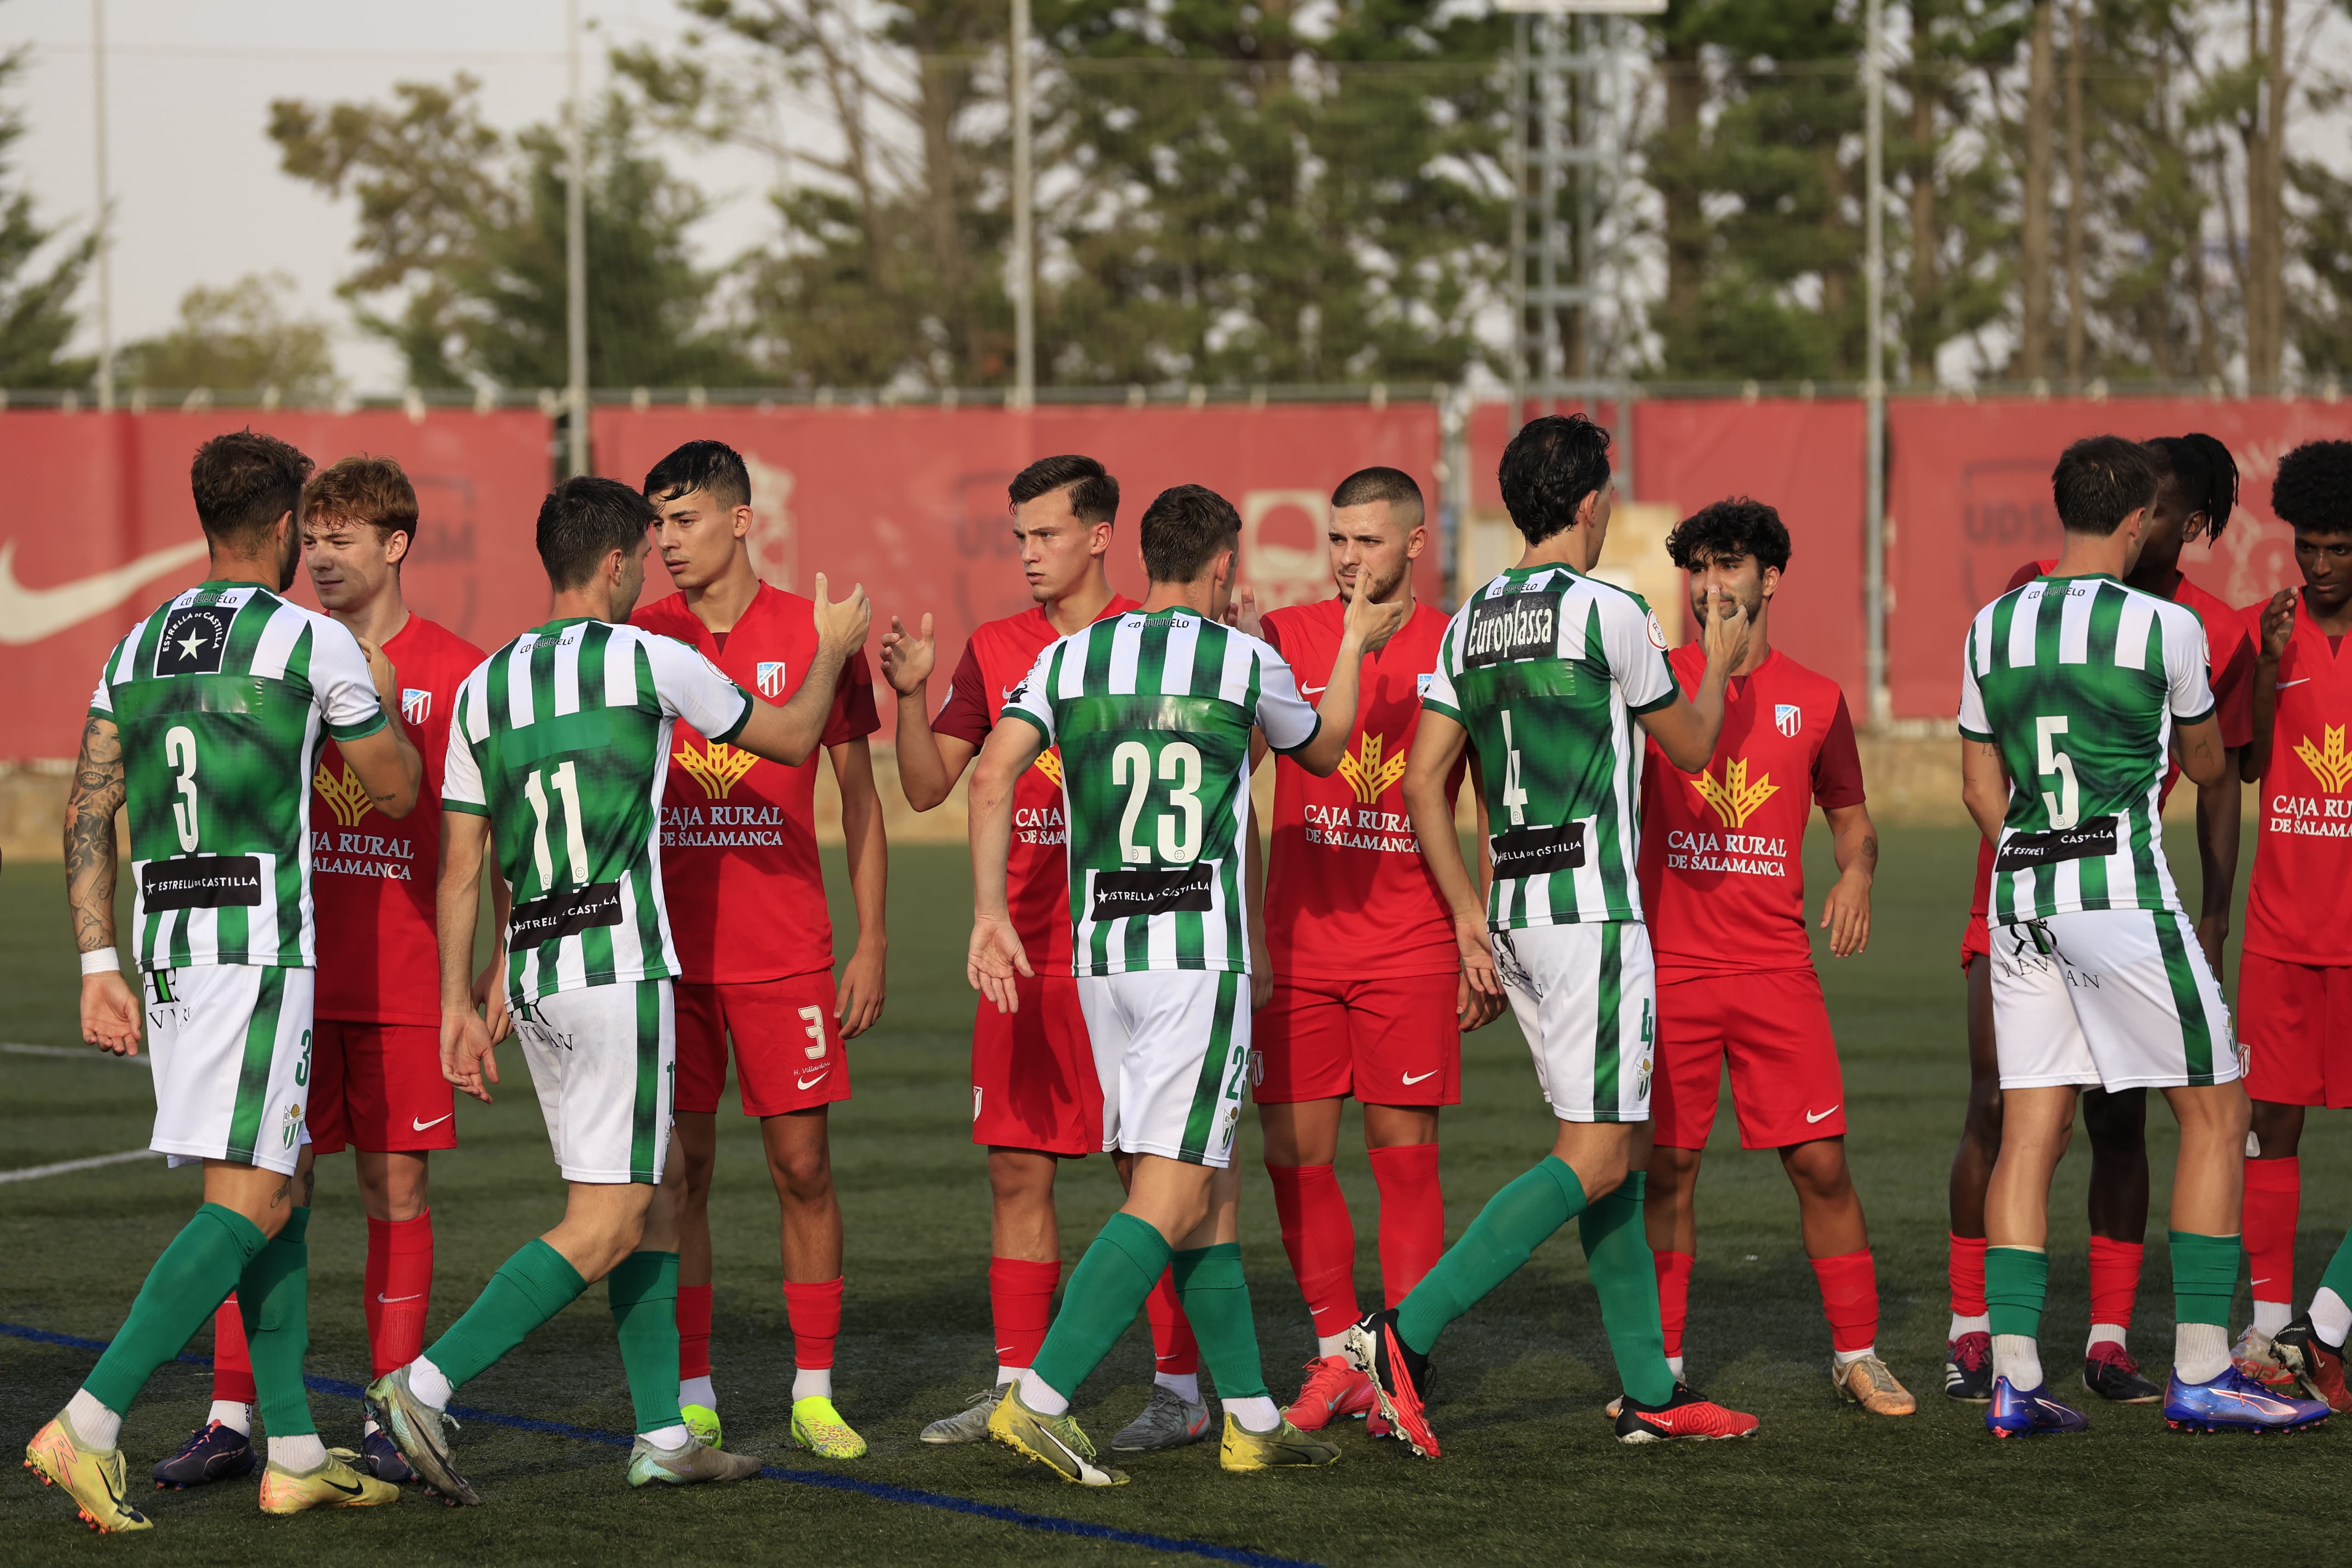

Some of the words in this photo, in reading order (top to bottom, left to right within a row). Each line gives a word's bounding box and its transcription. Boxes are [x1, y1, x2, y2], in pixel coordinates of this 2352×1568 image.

[180, 597, 192, 606] CD
[192, 593, 237, 604] GUIJUELO
[1493, 587, 1502, 595] CD
[1503, 583, 1538, 593] GUIJUELO
[2028, 591, 2041, 599] CD
[2042, 586, 2086, 597] GUIJUELO
[163, 612, 193, 652] ESTRELLA
[203, 612, 223, 649] CASTILLA
[1142, 617, 1190, 628] GUIJUELO
[1467, 599, 1553, 658] Europlassa
[520, 644, 531, 654] CD
[532, 636, 574, 650] GUIJUELO
[770, 664, 780, 672] MARTA
[1502, 709, 1528, 826] 4
[2036, 716, 2080, 830] 5
[165, 726, 198, 852] 3
[1112, 741, 1202, 864] 23
[2273, 795, 2319, 820] CAJA
[2324, 798, 2352, 819] RU
[524, 760, 589, 891] 11
[661, 806, 705, 831] CAJA
[710, 806, 784, 826] RURAL
[1016, 807, 1064, 830] CAJA
[1304, 804, 1352, 830] CAJA
[1357, 809, 1415, 832] RURA
[2270, 817, 2292, 833] DE
[338, 833, 414, 860] RURAL
[660, 832, 676, 846] DE
[678, 831, 783, 846] SALAMANCA
[1017, 830, 1037, 844] DE
[1305, 826, 1322, 844] DE
[1324, 830, 1421, 853] SALAMANCA
[1668, 830, 1720, 855] CAJA
[1725, 834, 1787, 857] RURAL
[313, 856, 412, 880] ALAMANCA
[1668, 854, 1688, 869] DE
[1691, 855, 1785, 877] SALAMANCA
[158, 879, 194, 891] ESTRELLA
[202, 877, 258, 887] CASTILLA
[1108, 891, 1154, 901] ESTRELLA
[798, 1005, 826, 1060] 3
[1640, 998, 1653, 1051] 4
[295, 1029, 312, 1087] 3
[802, 1062, 831, 1074] Villardón
